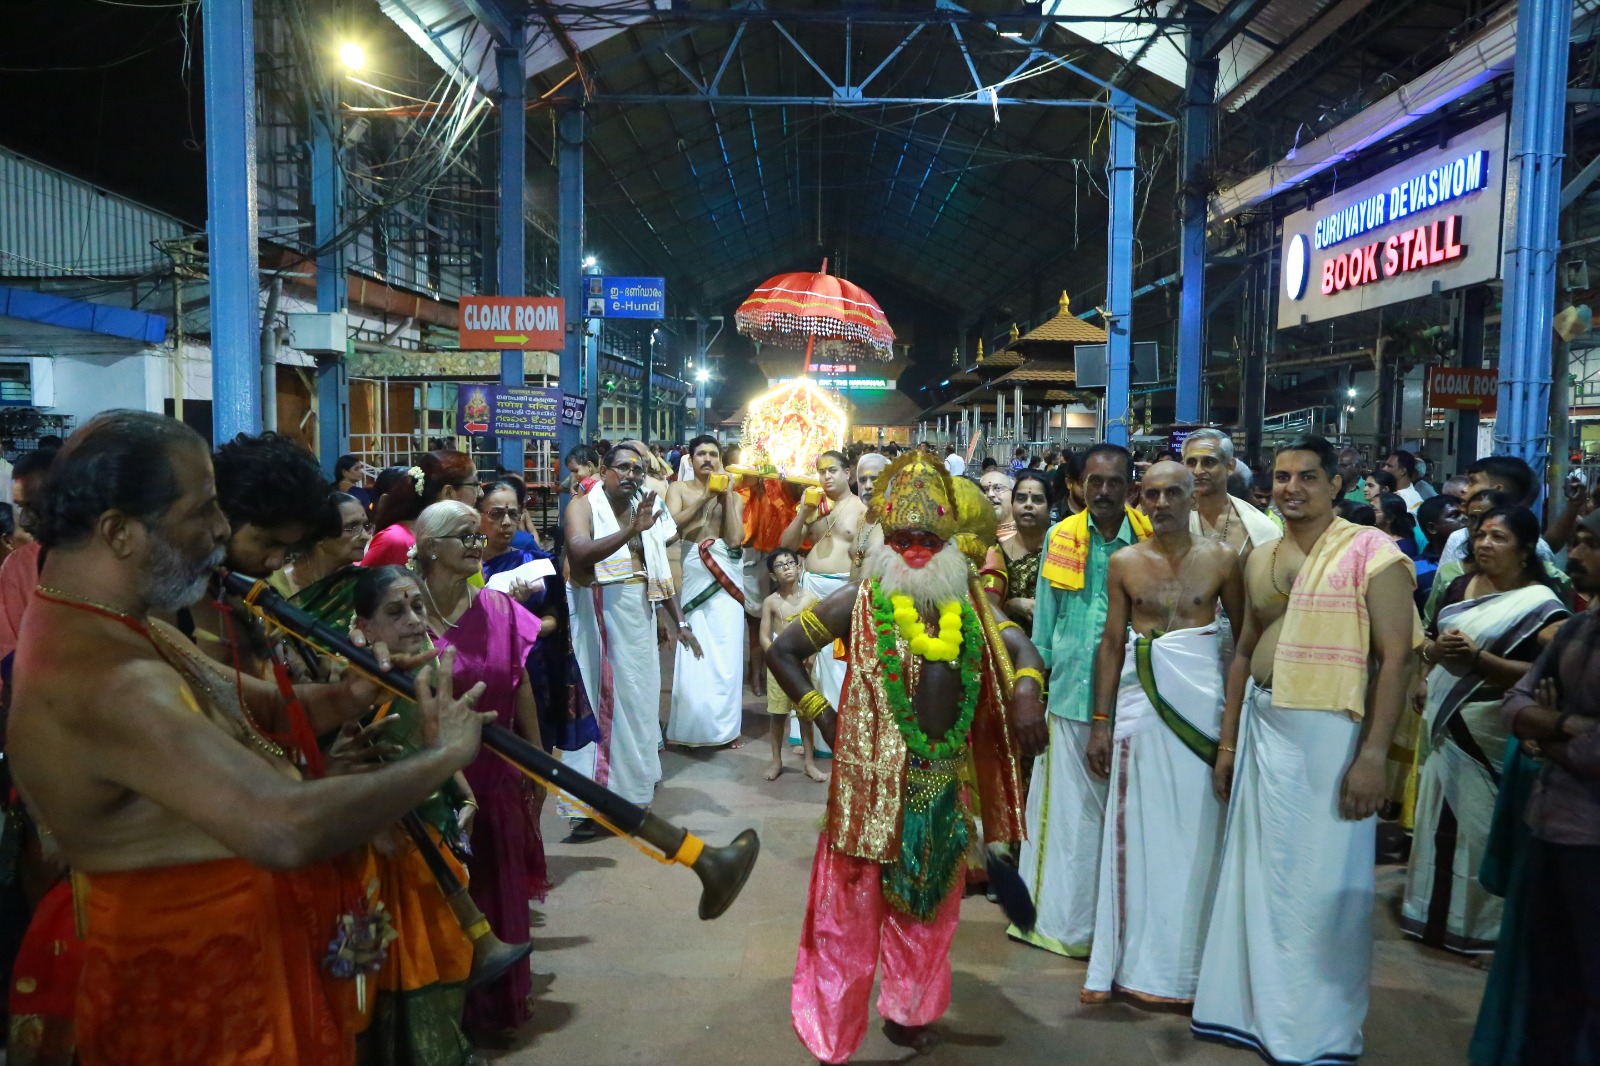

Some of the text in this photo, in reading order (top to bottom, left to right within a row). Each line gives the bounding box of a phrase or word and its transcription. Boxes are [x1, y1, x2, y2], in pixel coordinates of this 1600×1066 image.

[1315, 151, 1483, 249] GURUVAYUR DEVASWOM
[1321, 215, 1462, 296] BOOK STALL
[464, 304, 559, 331] CLOAK ROOM
[612, 300, 660, 311] e-Hundi
[1434, 373, 1498, 396] CLOAK ROO
